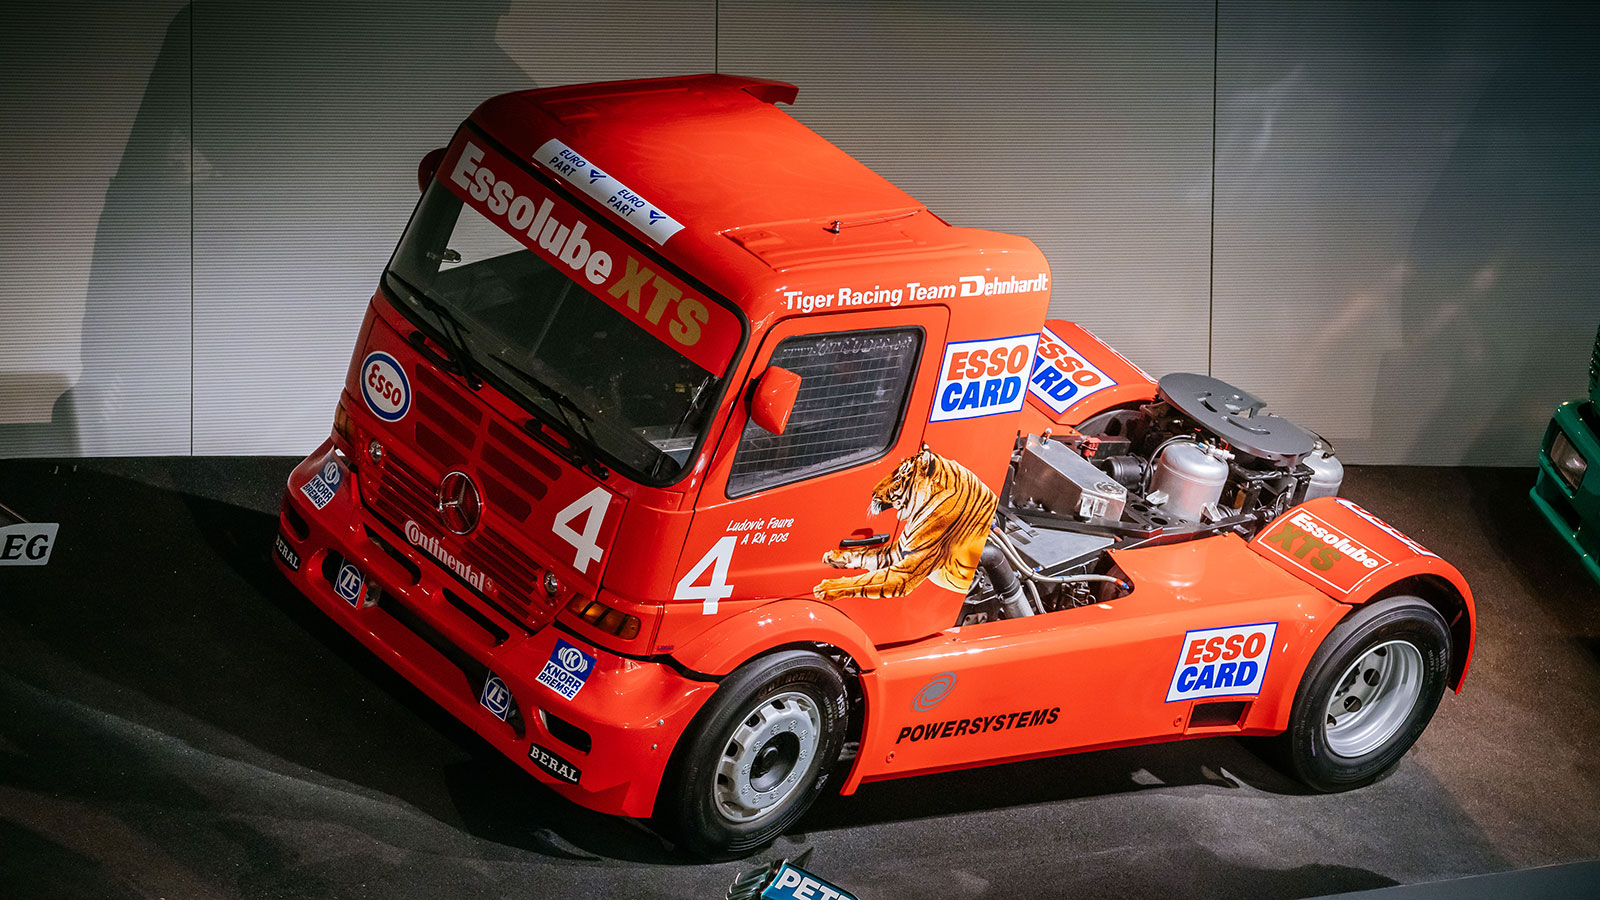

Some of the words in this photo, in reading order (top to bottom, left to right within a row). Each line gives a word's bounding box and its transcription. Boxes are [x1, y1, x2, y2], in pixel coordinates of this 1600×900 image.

[549, 157, 577, 178] PART
[559, 149, 586, 168] EURO
[607, 196, 635, 217] PART
[617, 188, 645, 208] EURO
[450, 141, 613, 285] Essolube
[607, 255, 710, 346] XTS
[783, 290, 835, 313] Tiger
[838, 286, 902, 307] Racing
[907, 282, 956, 301] Team
[959, 273, 1048, 297] Dehnhardt
[947, 344, 1029, 381] ESSO
[941, 376, 1021, 412] CARD
[303, 484, 326, 507] BREMSE
[310, 476, 333, 501] KNORR
[552, 487, 613, 573] 4
[726, 518, 764, 533] Ludovic
[767, 517, 794, 530] Faure
[741, 533, 749, 545] A
[751, 532, 768, 544] Rh
[770, 532, 790, 545] pos
[1289, 513, 1379, 569] Essolube
[0, 534, 48, 560] EG
[405, 520, 484, 592] Continental
[1268, 523, 1342, 571] XTS
[343, 567, 361, 595] ZF
[672, 536, 738, 616] 4
[1185, 632, 1267, 665] ESSO
[537, 671, 577, 699] BREMSE
[544, 663, 582, 691] KNORR
[1176, 660, 1260, 694] CARD
[490, 681, 509, 707] ZF
[896, 707, 1061, 745] POWERSYSTEMS
[529, 745, 578, 783] BERAL
[774, 867, 852, 900] PET
